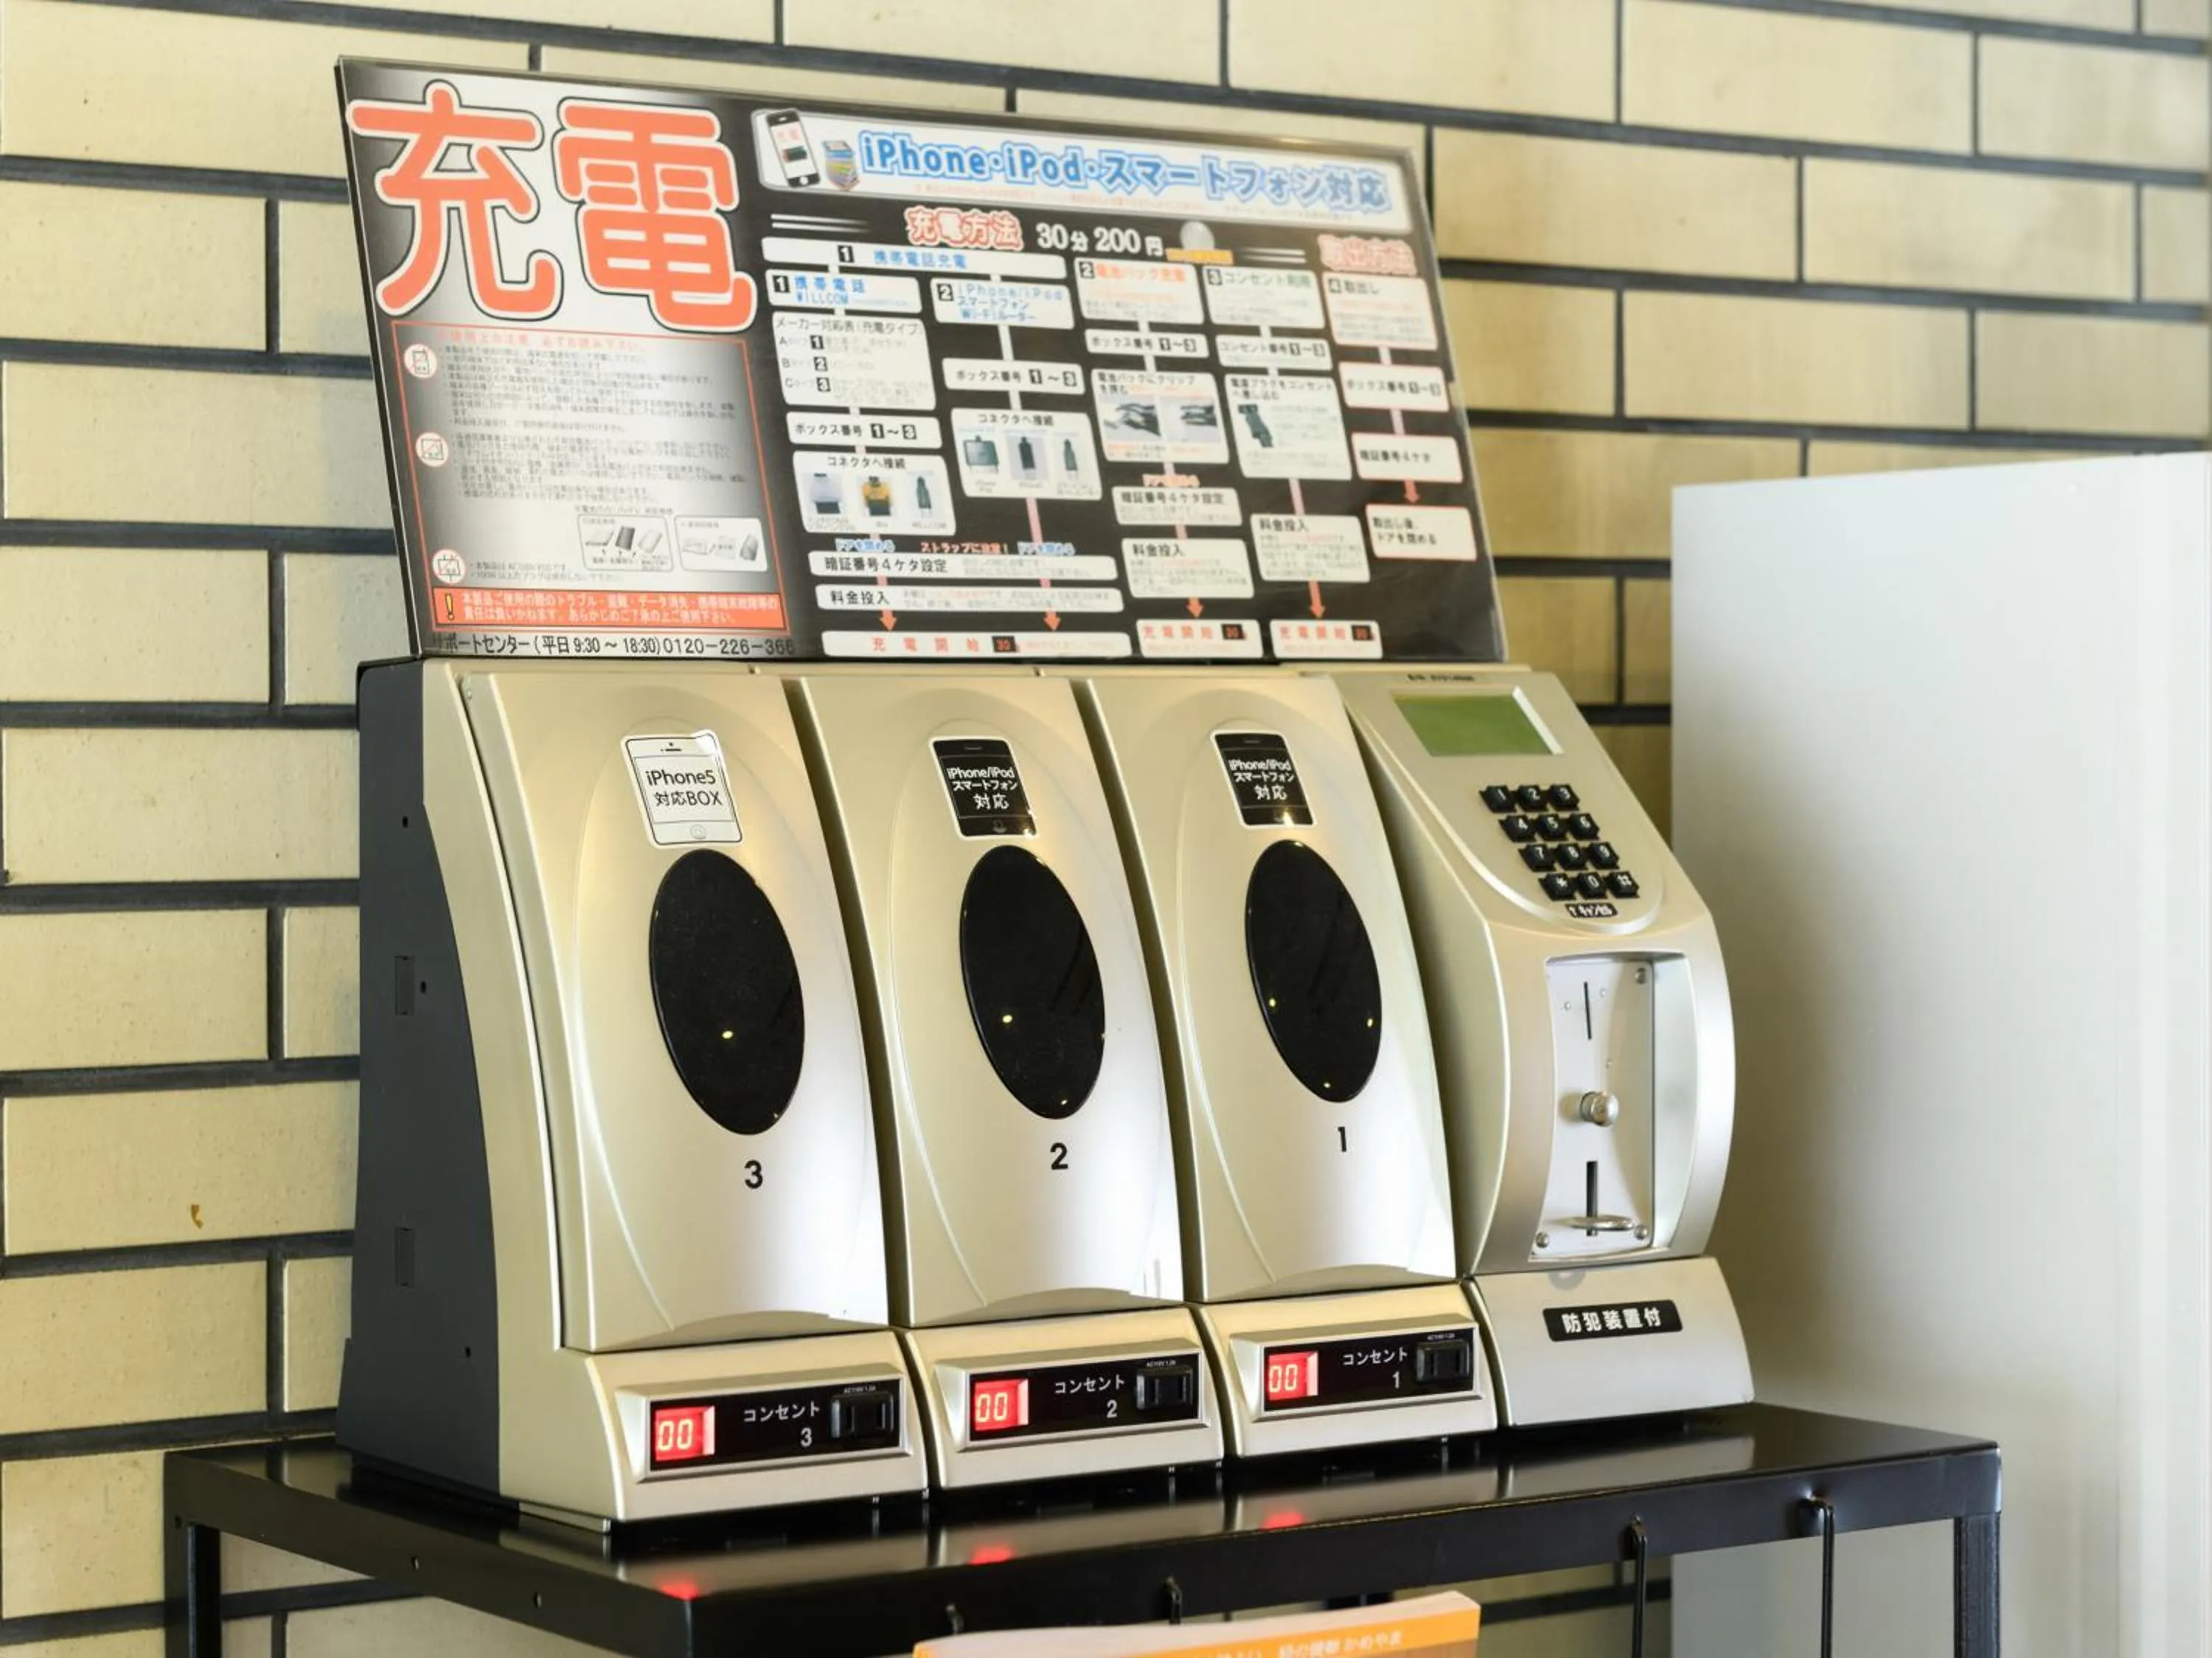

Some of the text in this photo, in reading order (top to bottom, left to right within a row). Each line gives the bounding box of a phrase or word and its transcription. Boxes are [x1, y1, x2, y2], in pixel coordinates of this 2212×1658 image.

[348, 81, 755, 330] 充電
[905, 207, 1023, 249] 充電方法
[1037, 224, 1164, 257] 30分 200円
[838, 245, 967, 270] 1 携帯電話充電
[1079, 261, 1095, 279] 2
[773, 275, 866, 294] 1 携帯電話
[937, 284, 953, 301] 2
[958, 295, 1029, 311] スマートフォン
[810, 335, 824, 350] 1
[1091, 336, 1153, 350] ボックス番号
[814, 357, 828, 371] 2
[816, 377, 831, 392] 3
[956, 370, 1022, 384] ボックス番号
[978, 413, 1054, 427] コネクタへ接続
[795, 423, 863, 437] ボックス番号
[827, 455, 908, 470] コネクタへ接続
[1259, 518, 1309, 533] 料金投入
[1132, 544, 1186, 558] 料金投入
[824, 556, 947, 573] 暗証番号4ケタ設定
[830, 590, 890, 606] 料金投入
[947, 766, 1015, 779] iPhone/iPod
[1228, 758, 1291, 771] iPhone/iPod
[645, 769, 717, 785] iPhone5
[952, 780, 1018, 791] スマートフォン
[1234, 771, 1295, 783] スマートフォン
[654, 791, 724, 807] 対応BOX
[1254, 784, 1288, 800] 対応
[973, 793, 1009, 809] 対応
[1337, 1125, 1349, 1153] 1
[1050, 1142, 1068, 1170] 2
[743, 1159, 764, 1189] 3
[1561, 1306, 1660, 1333] 防犯装置付
[1343, 1346, 1408, 1366] コンセント
[1054, 1374, 1125, 1394] コンセント
[1268, 1363, 1298, 1392] 00
[1392, 1370, 1400, 1389] 1
[743, 1401, 820, 1423] コンセント
[975, 1391, 1008, 1423] 00
[1106, 1399, 1118, 1418] 2
[658, 1418, 694, 1451] 00
[800, 1427, 813, 1447] 3
